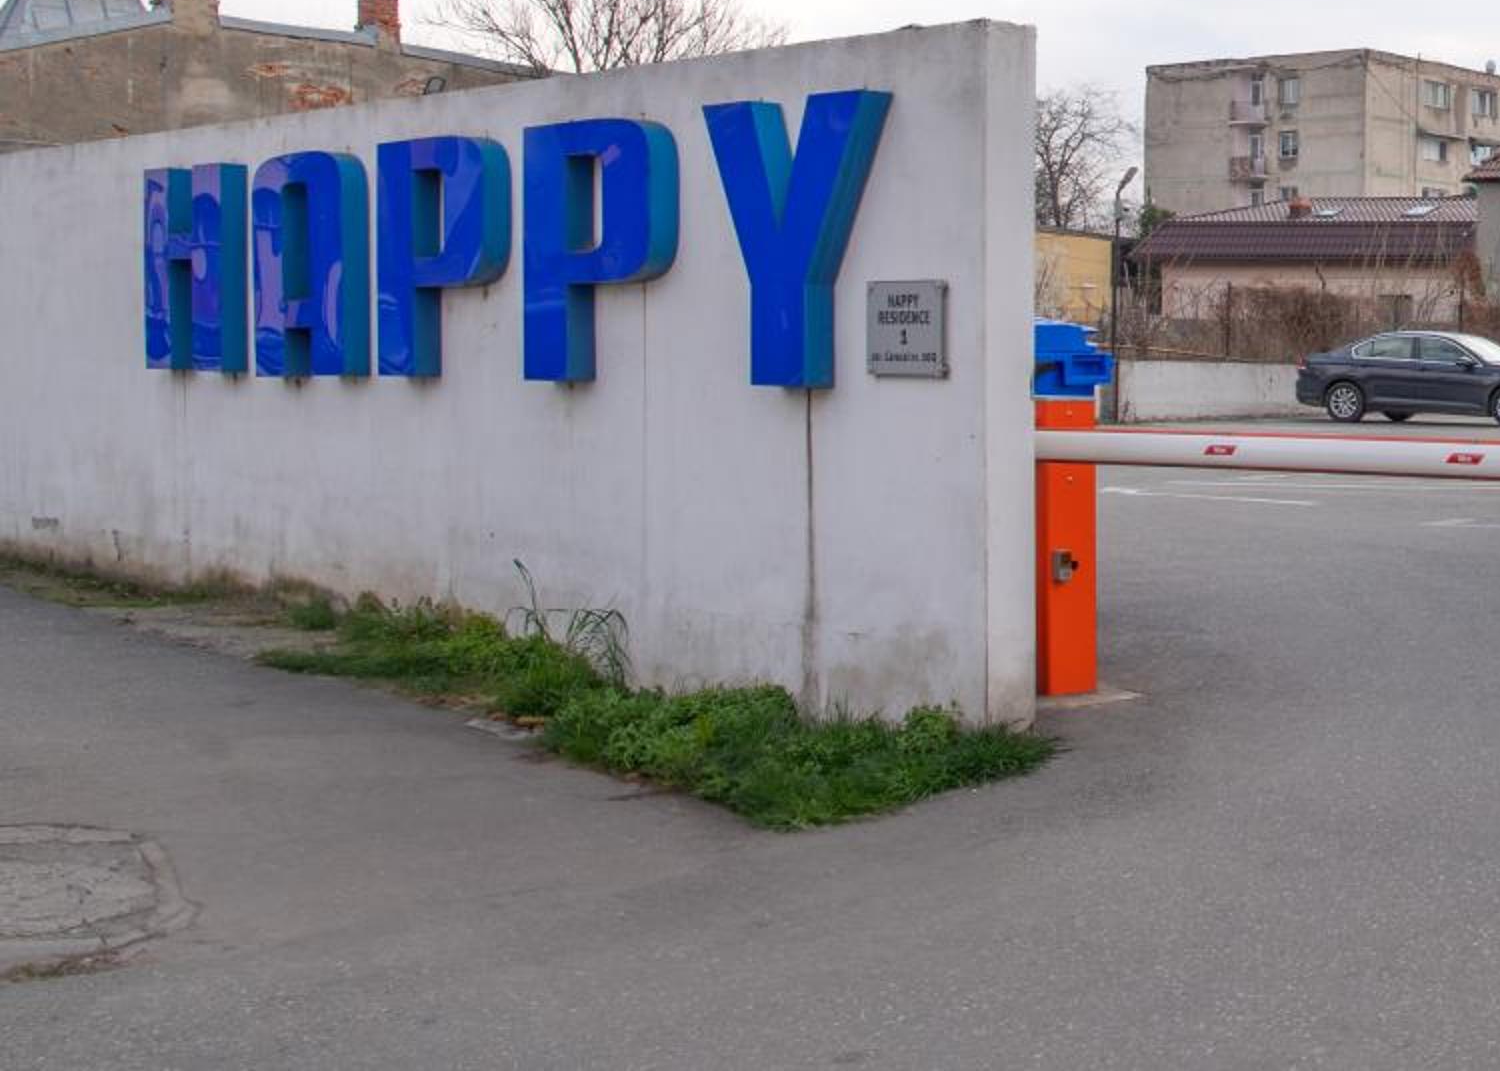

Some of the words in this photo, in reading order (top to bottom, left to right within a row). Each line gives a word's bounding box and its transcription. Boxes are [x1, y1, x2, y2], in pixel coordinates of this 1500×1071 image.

[143, 89, 893, 388] HAPPY
[887, 293, 919, 308] HAPPY
[877, 310, 931, 325] RESIDENCE
[899, 328, 908, 345] 1
